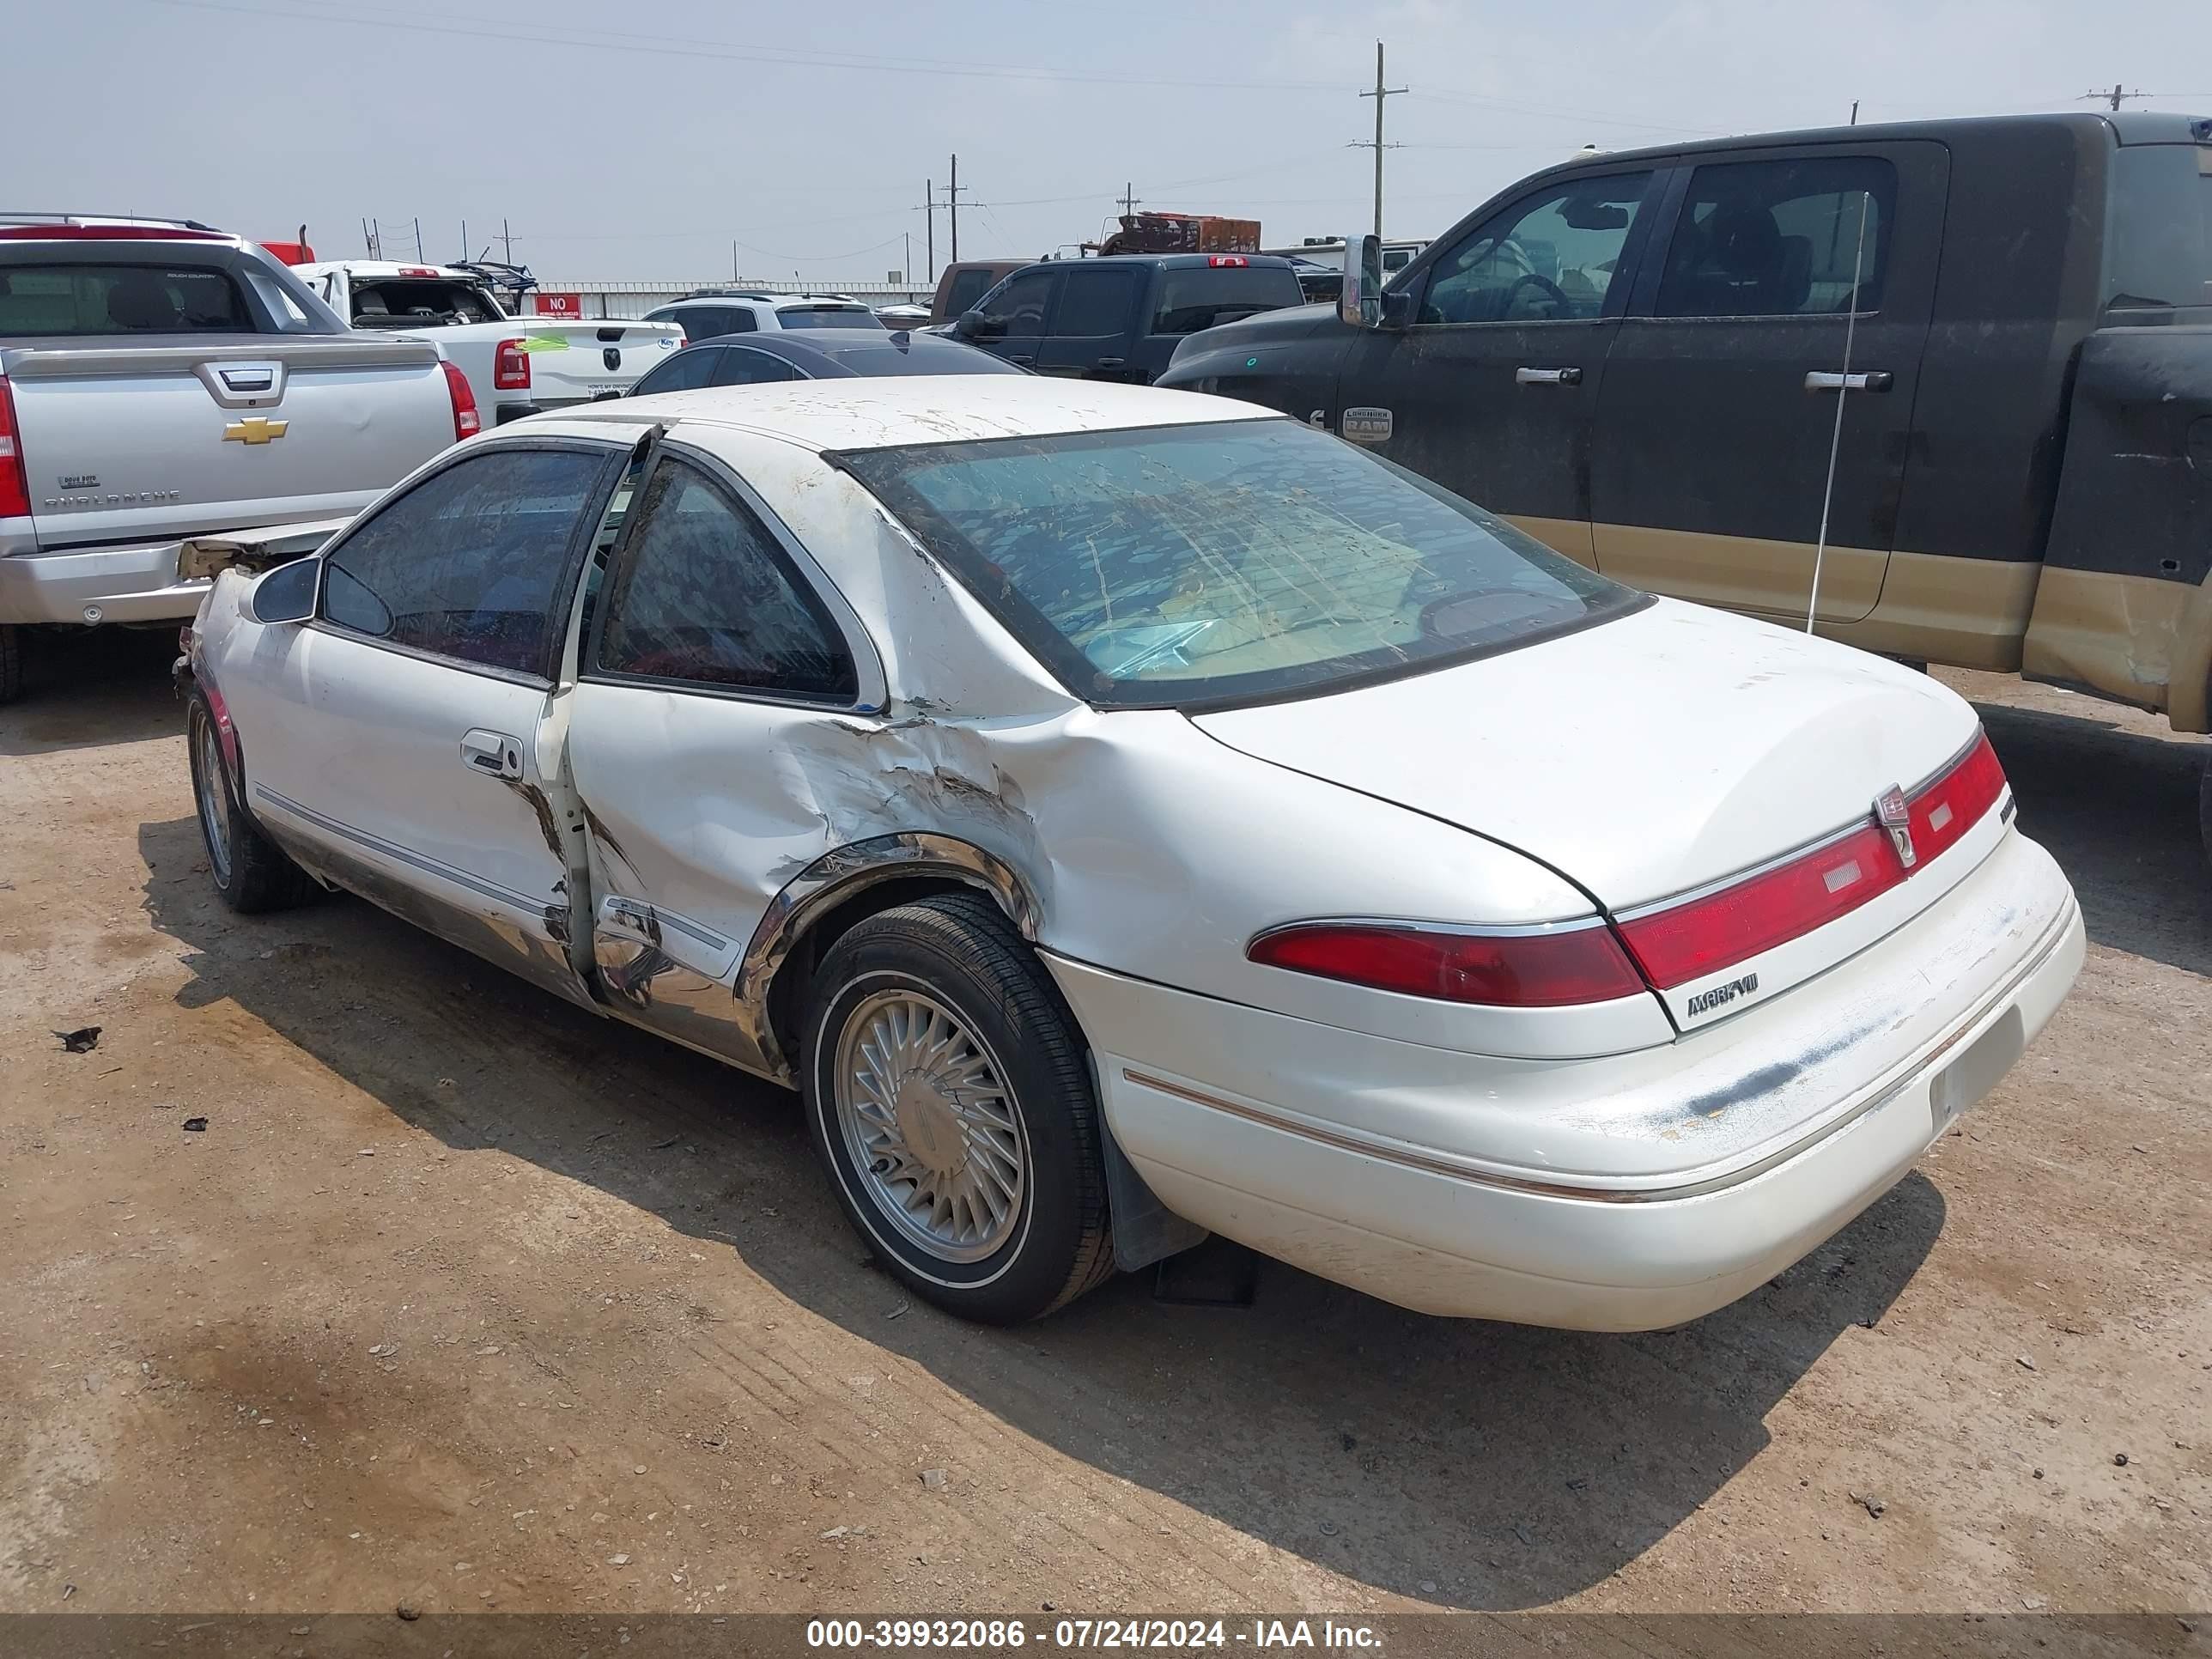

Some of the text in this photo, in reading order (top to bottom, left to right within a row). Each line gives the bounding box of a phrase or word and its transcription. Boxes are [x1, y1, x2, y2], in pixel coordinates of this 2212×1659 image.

[550, 297, 566, 310] NO
[660, 338, 674, 347] Key
[1346, 421, 1389, 431] RAM
[45, 489, 180, 506] AVALANCHE
[1688, 981, 1735, 1017] MARK
